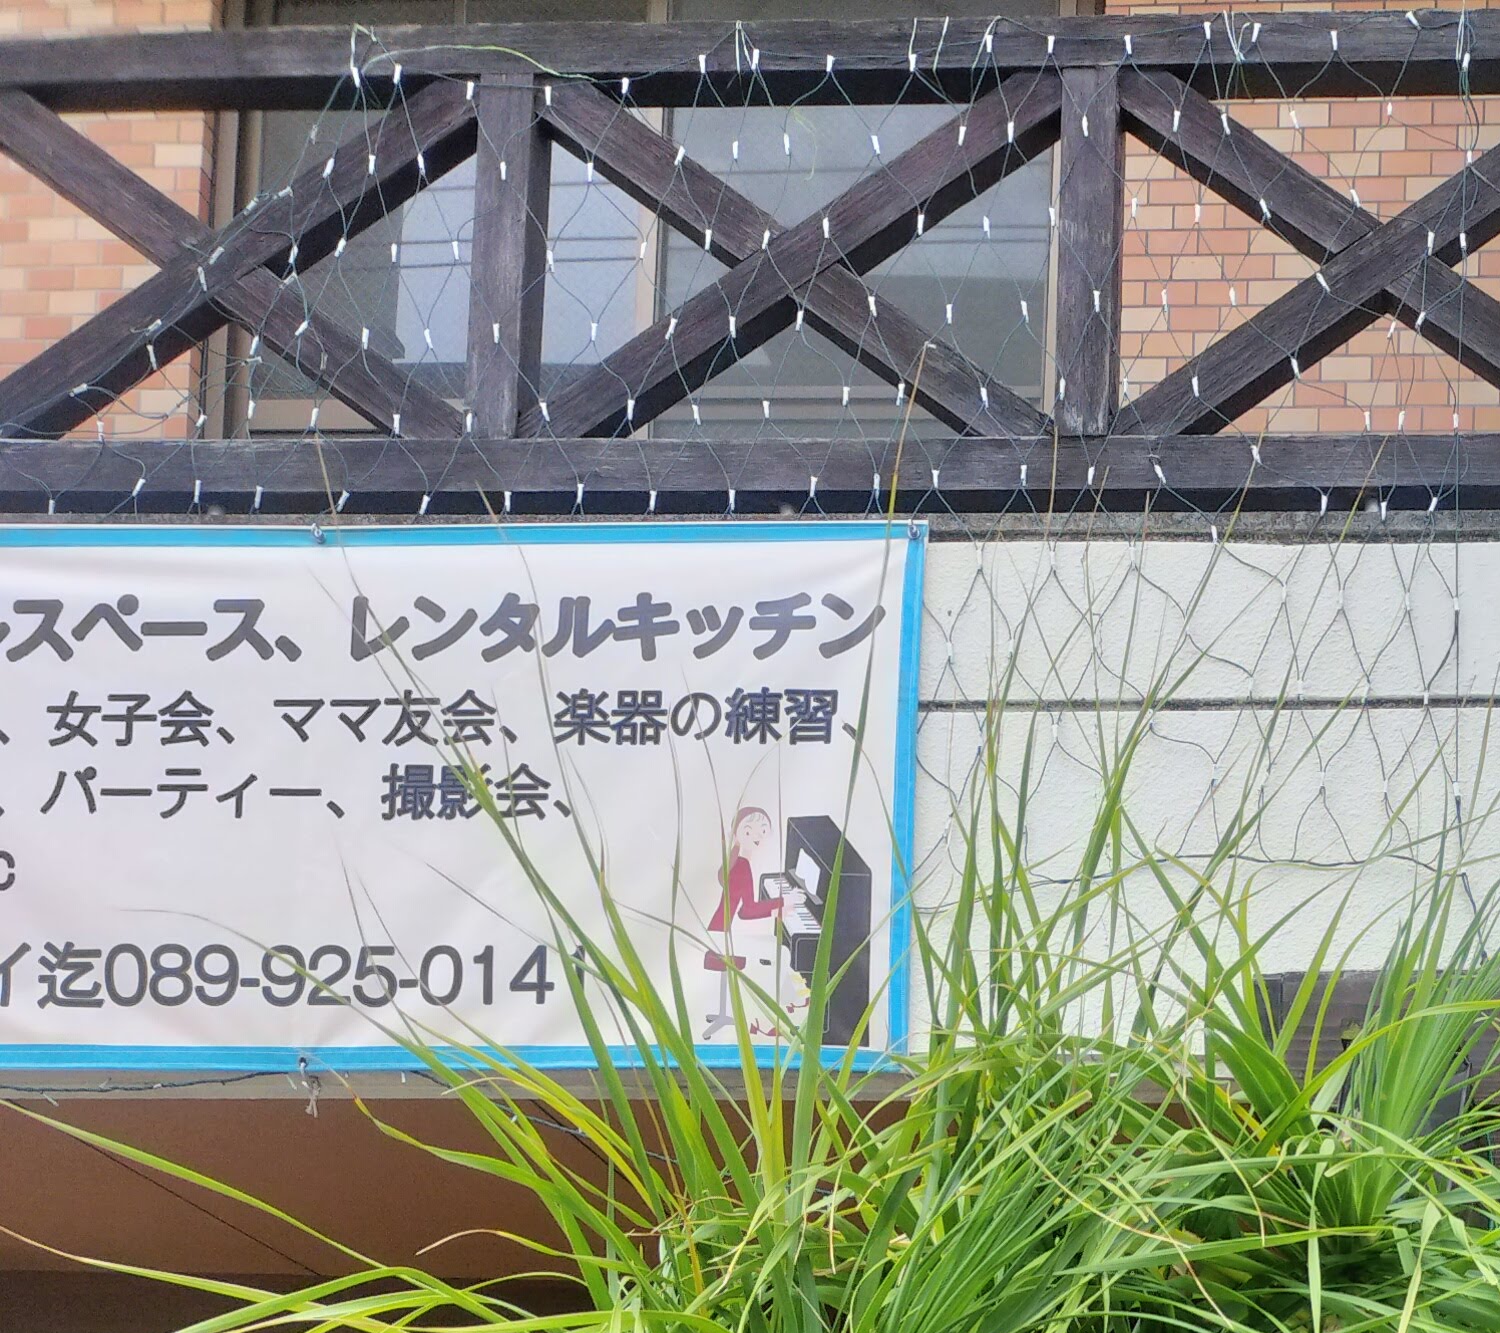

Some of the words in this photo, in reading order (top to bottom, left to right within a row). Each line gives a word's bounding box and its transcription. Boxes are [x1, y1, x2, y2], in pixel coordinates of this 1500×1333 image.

[0, 592, 887, 662] スペース、レンタルキッチン
[0, 763, 572, 820] パーティー、撮影会、
